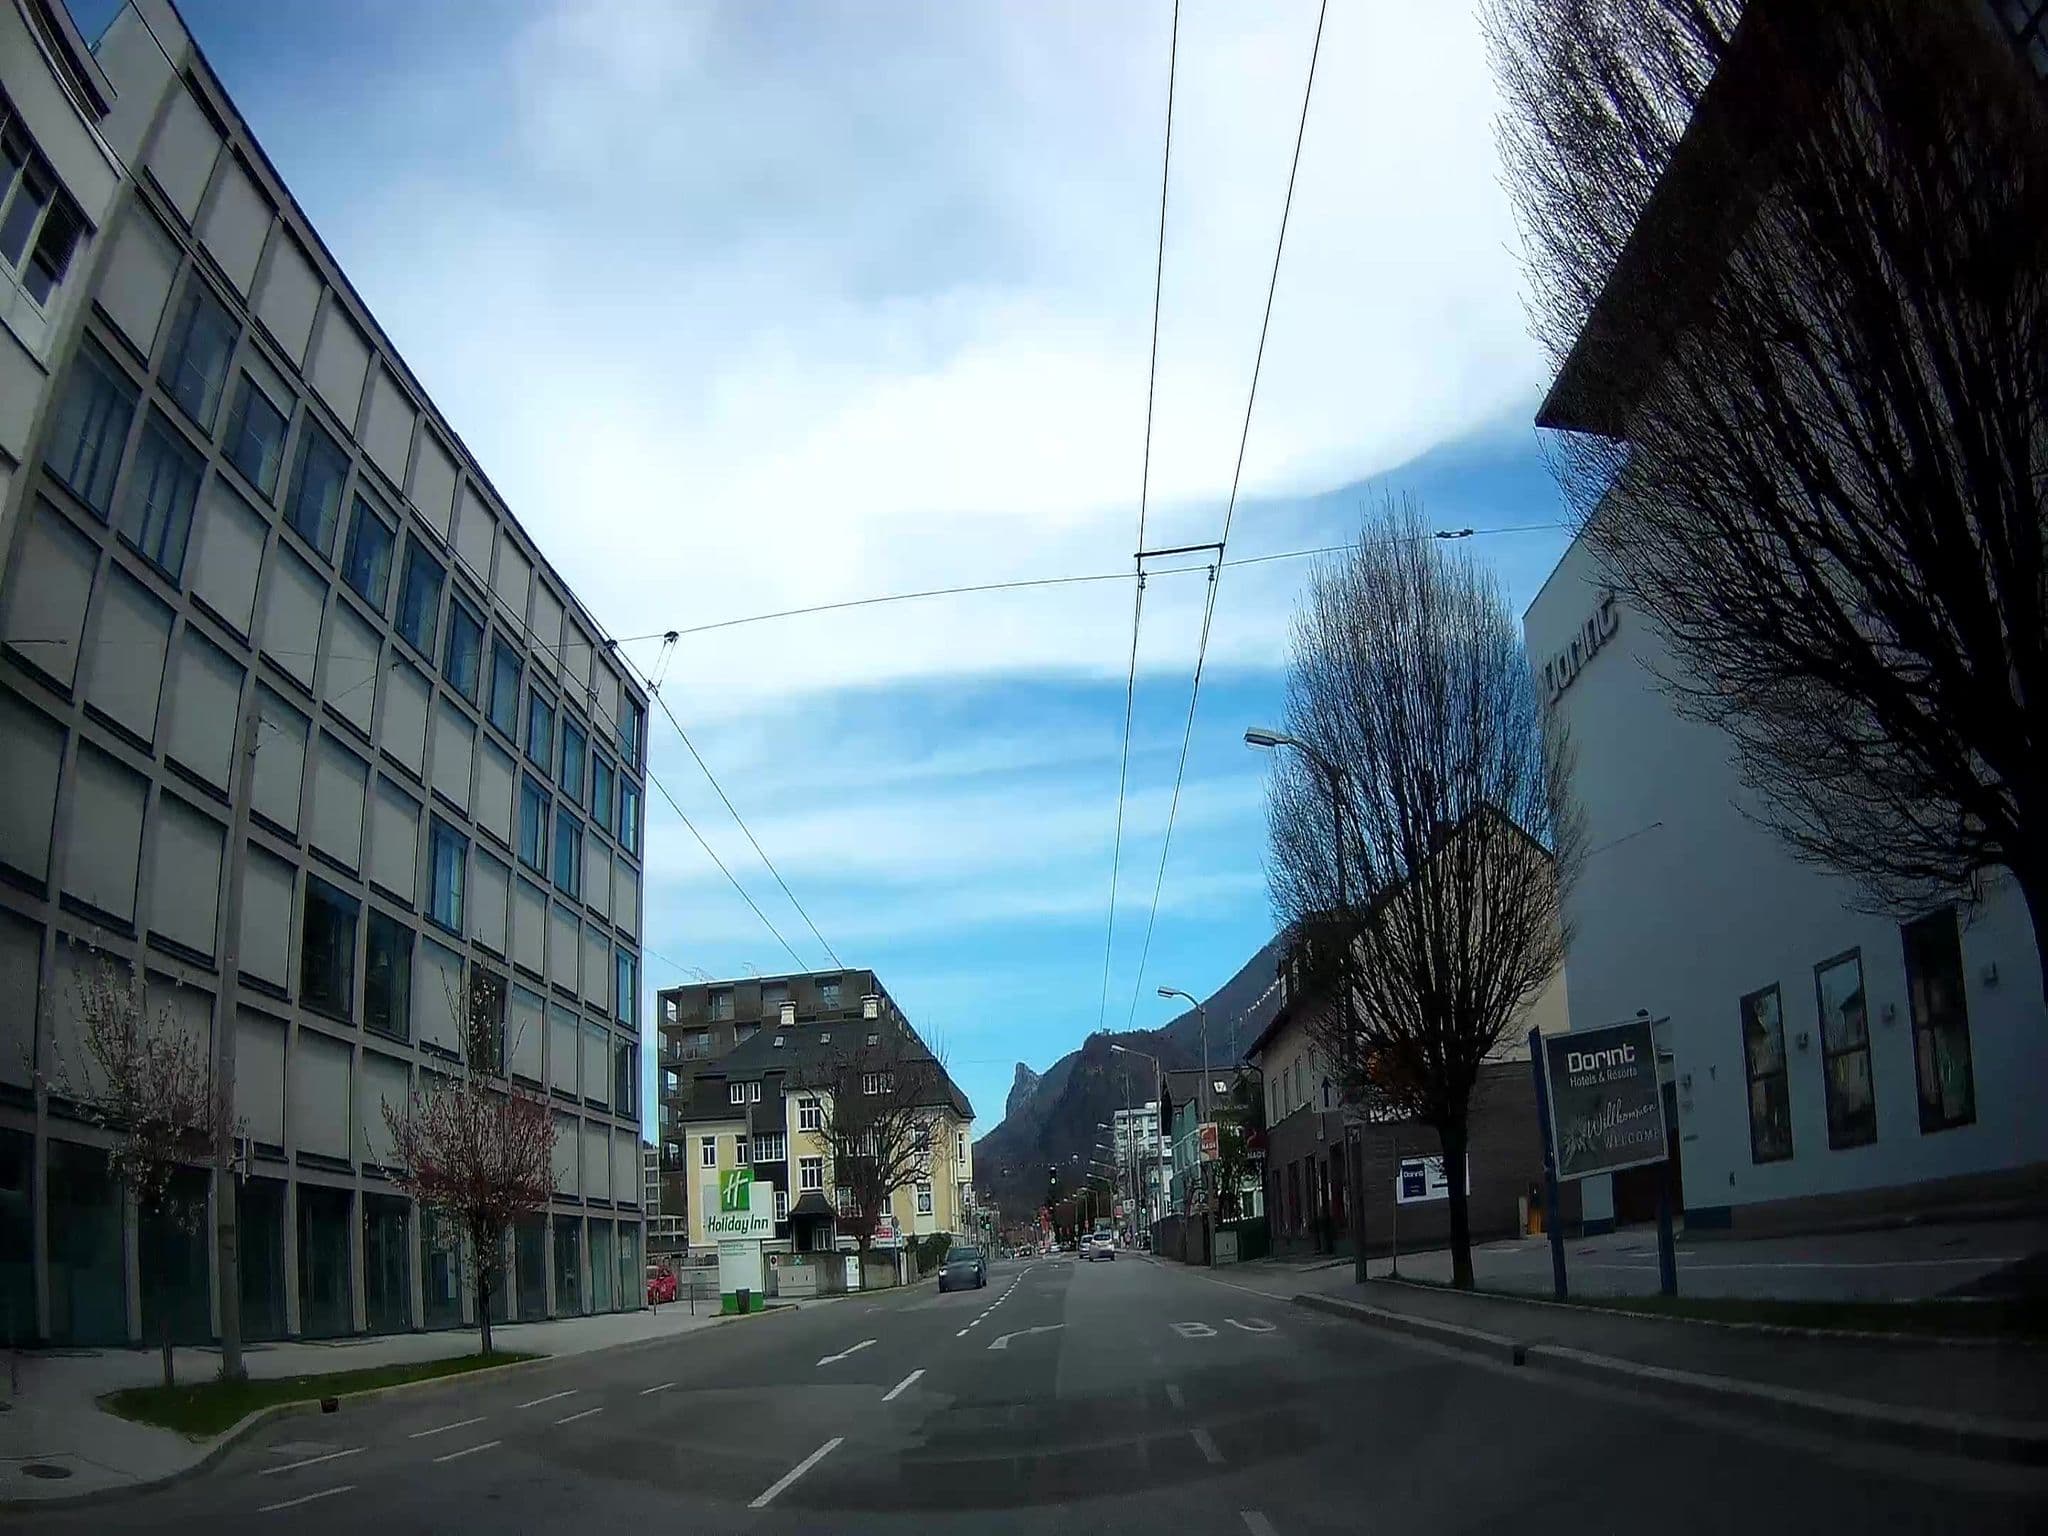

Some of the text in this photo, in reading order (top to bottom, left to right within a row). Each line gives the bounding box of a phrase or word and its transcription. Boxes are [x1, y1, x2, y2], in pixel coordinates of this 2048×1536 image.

[1567, 1043, 1635, 1072] Dorint
[1570, 1072, 1597, 1087] Hotels
[1587, 1098, 1657, 1138] Willkommen
[708, 1214, 768, 1234] Holiday Inn
